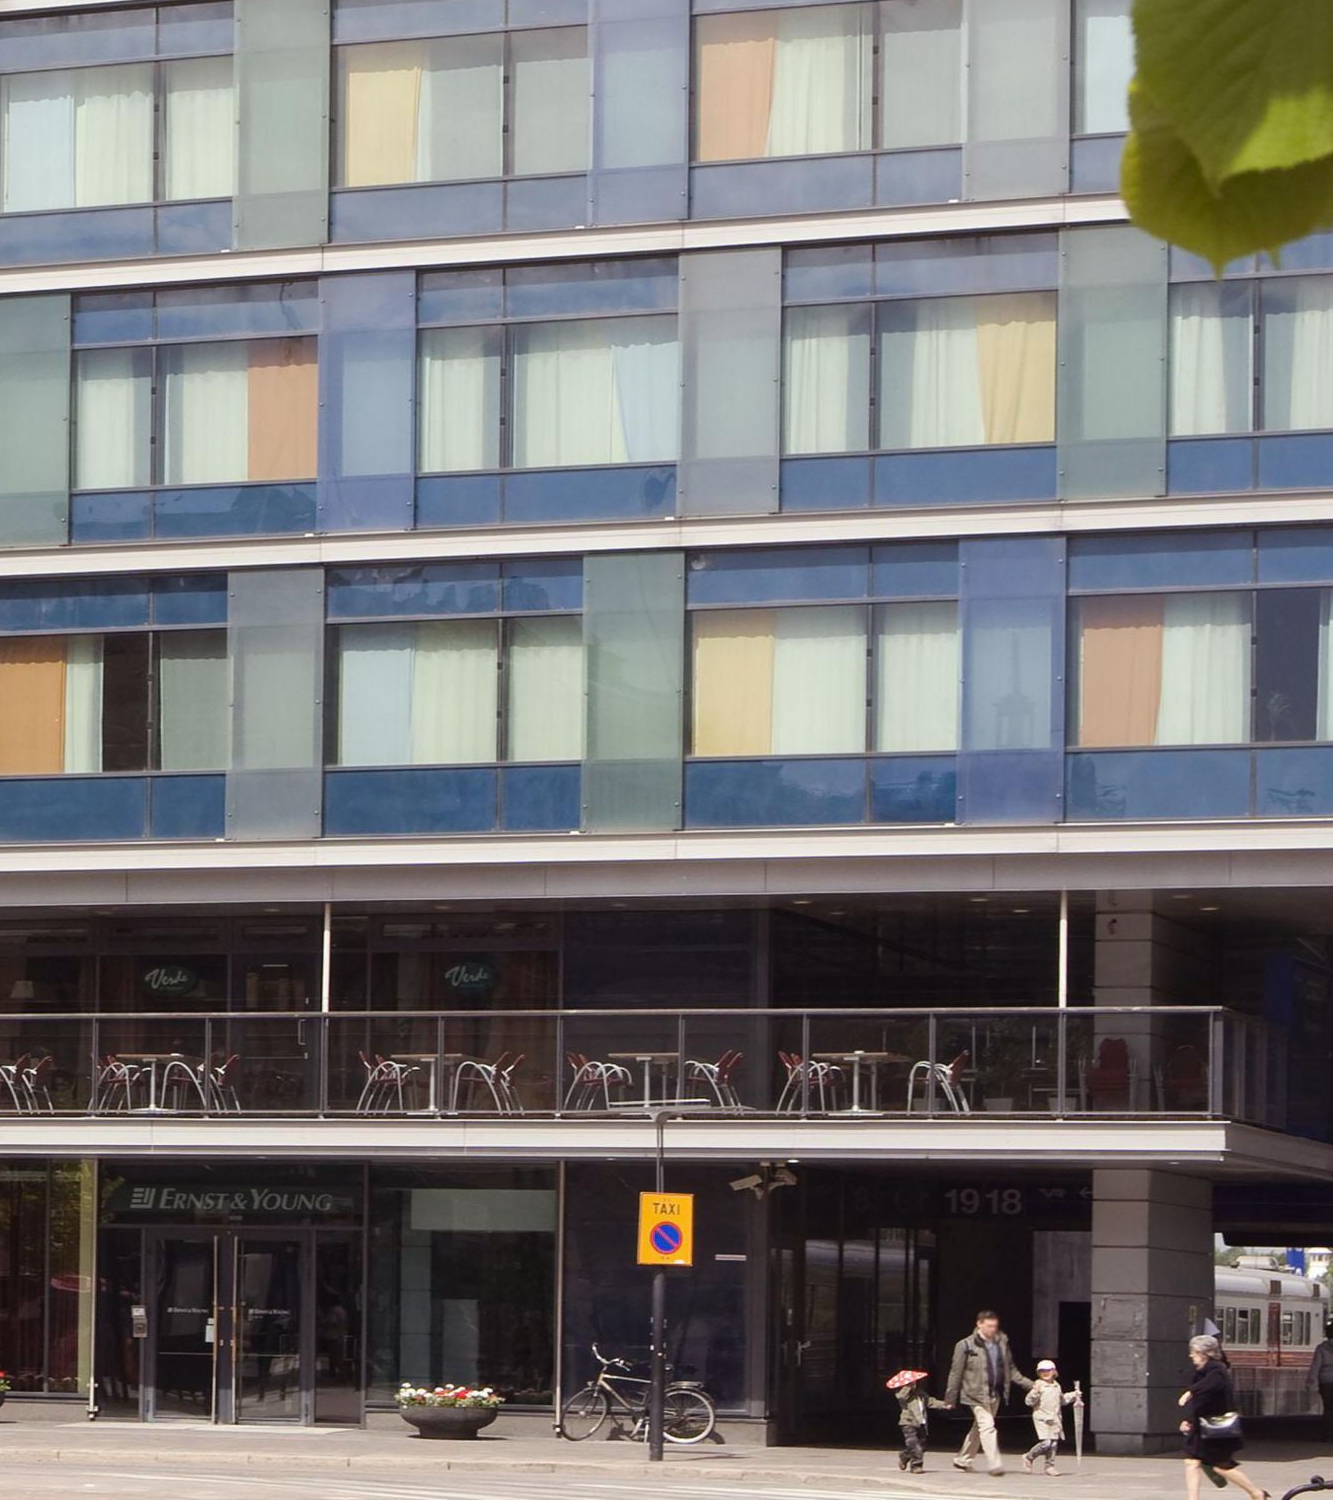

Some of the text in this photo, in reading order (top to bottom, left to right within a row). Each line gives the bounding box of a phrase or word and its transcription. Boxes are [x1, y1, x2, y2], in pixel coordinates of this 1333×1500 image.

[158, 1187, 332, 1211] ERNST & YOUNG
[653, 1202, 681, 1215] TAXI
